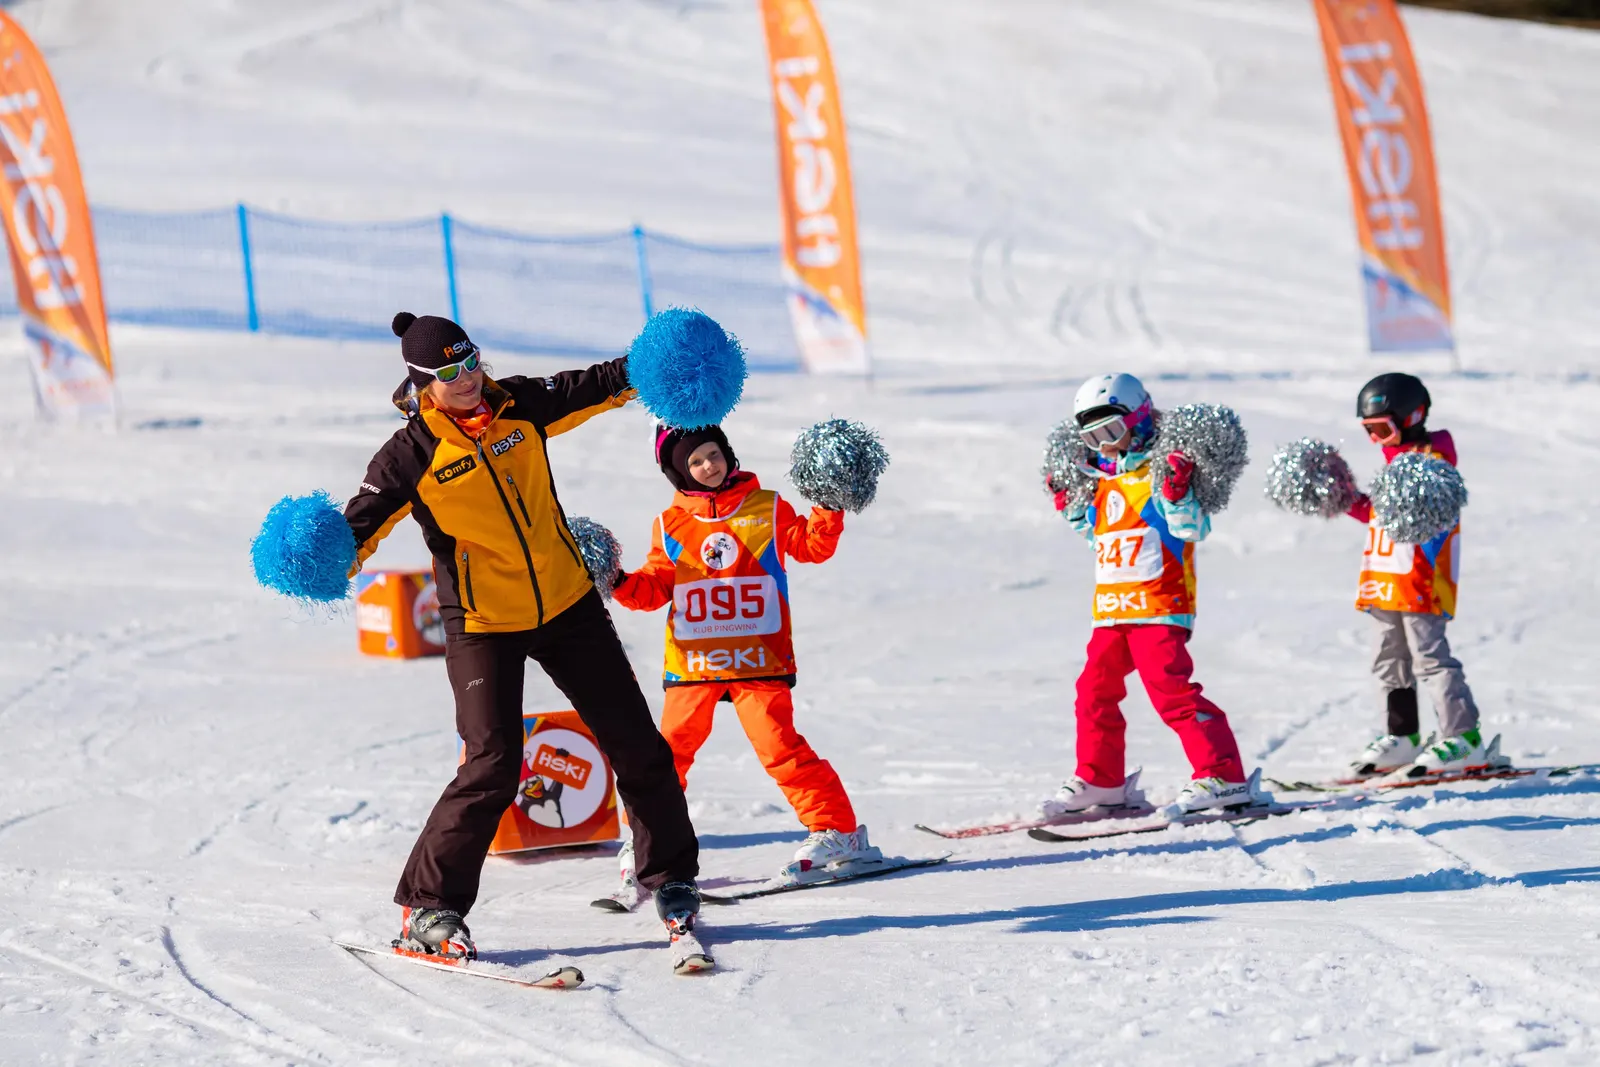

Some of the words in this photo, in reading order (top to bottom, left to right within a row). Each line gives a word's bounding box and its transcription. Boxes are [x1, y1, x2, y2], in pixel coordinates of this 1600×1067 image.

[438, 459, 472, 481] somfy
[684, 583, 765, 623] 095
[692, 625, 713, 634] KLUB
[714, 623, 758, 633] PINGWINA
[1215, 786, 1246, 798] HEAD
